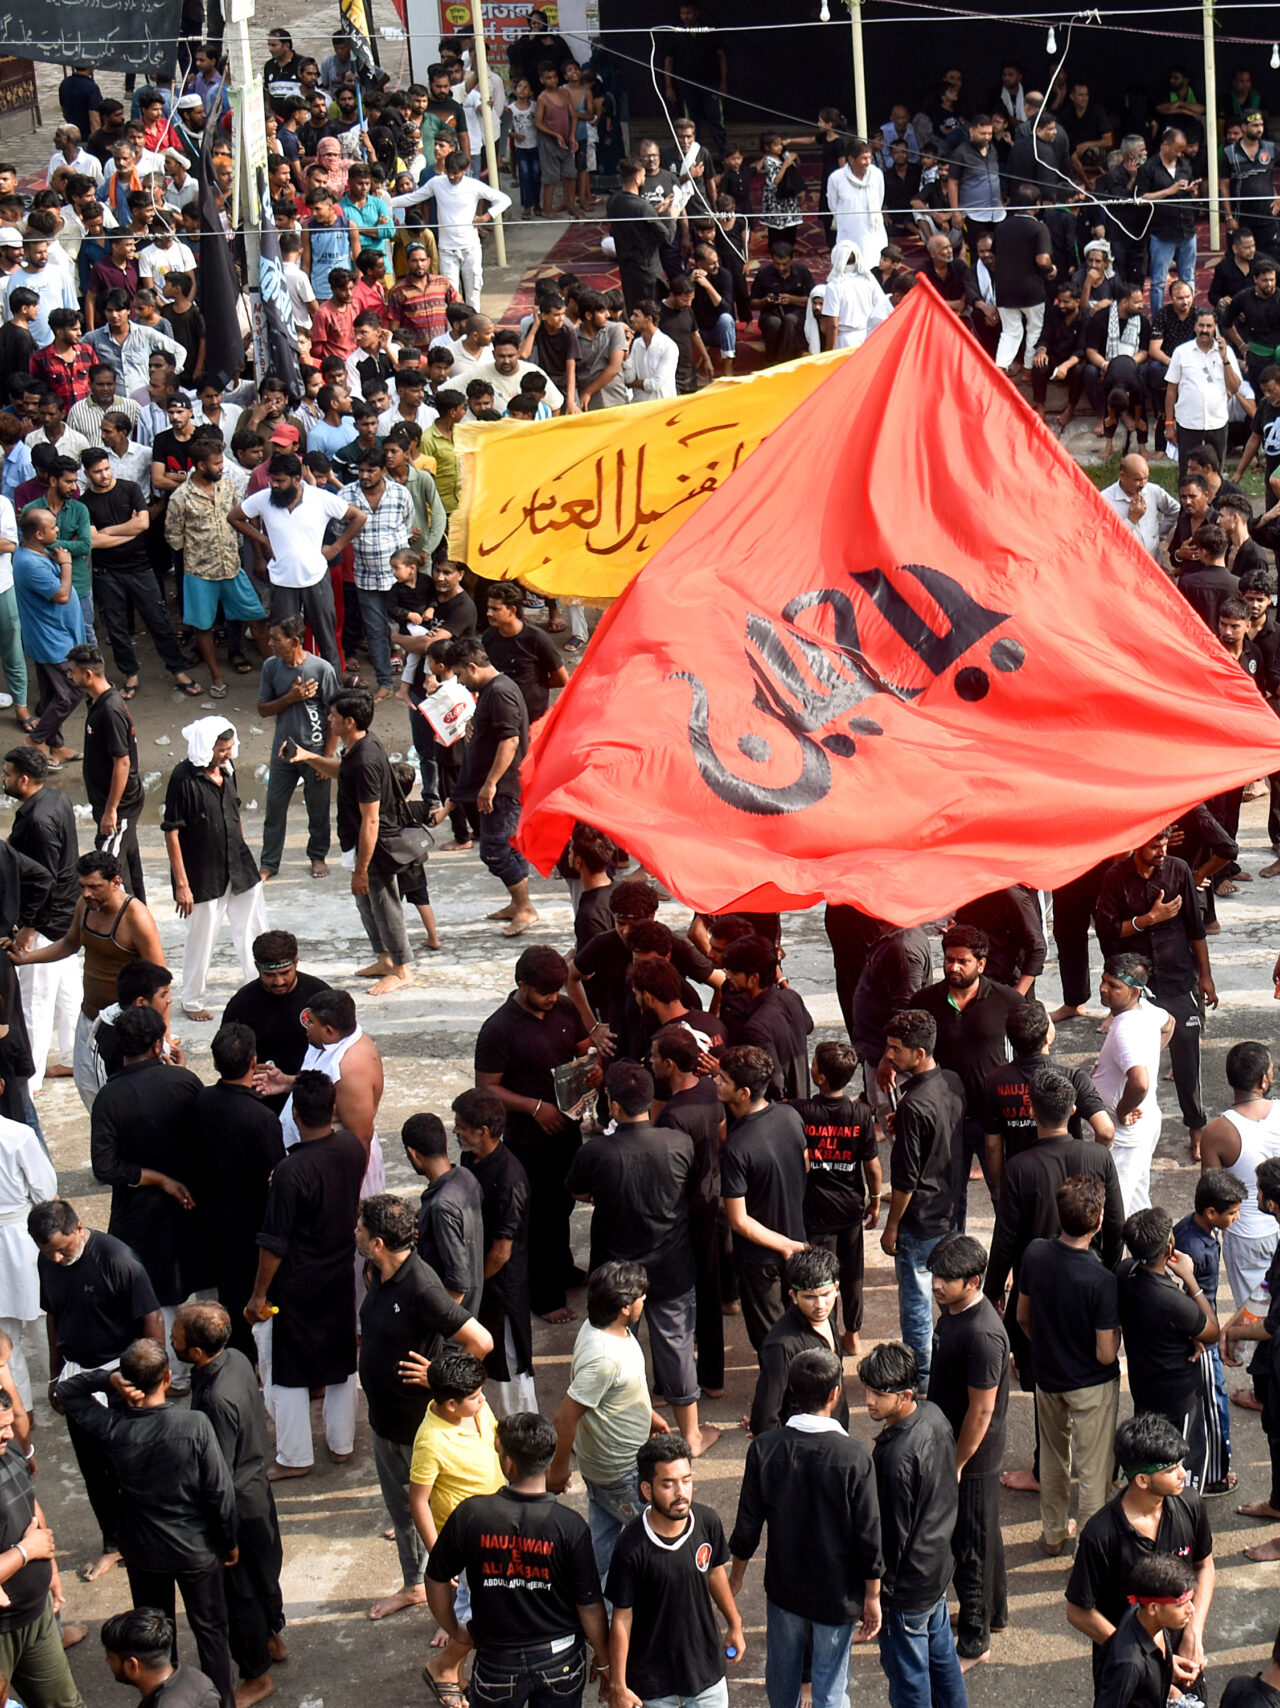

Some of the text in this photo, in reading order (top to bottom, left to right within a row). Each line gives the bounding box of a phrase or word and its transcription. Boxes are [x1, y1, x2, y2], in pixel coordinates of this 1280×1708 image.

[480, 1533, 554, 1555] NAUJAWAN
[482, 1561, 551, 1580] ALI AKBAR
